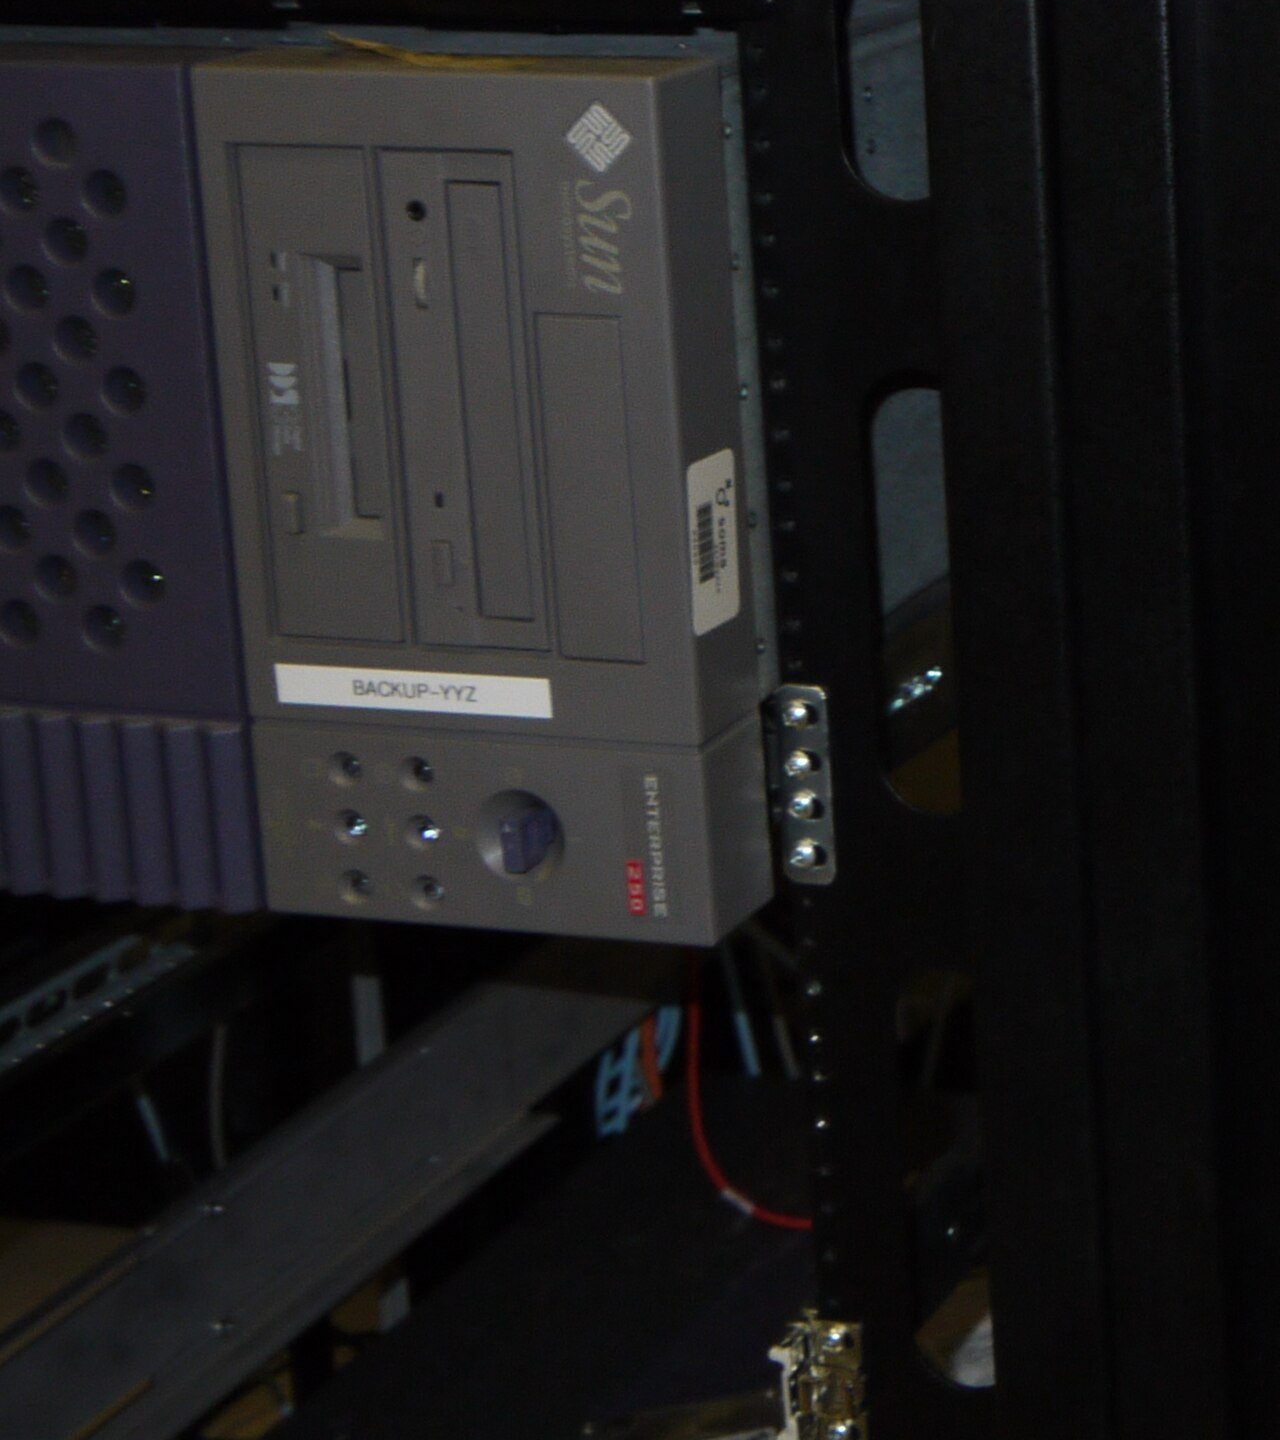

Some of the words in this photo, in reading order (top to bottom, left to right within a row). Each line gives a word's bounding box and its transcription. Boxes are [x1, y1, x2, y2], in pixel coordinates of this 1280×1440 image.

[575, 178, 632, 295] Sun
[352, 679, 477, 702] BACKUP-YYZ
[644, 776, 668, 918] ENTERPRISE
